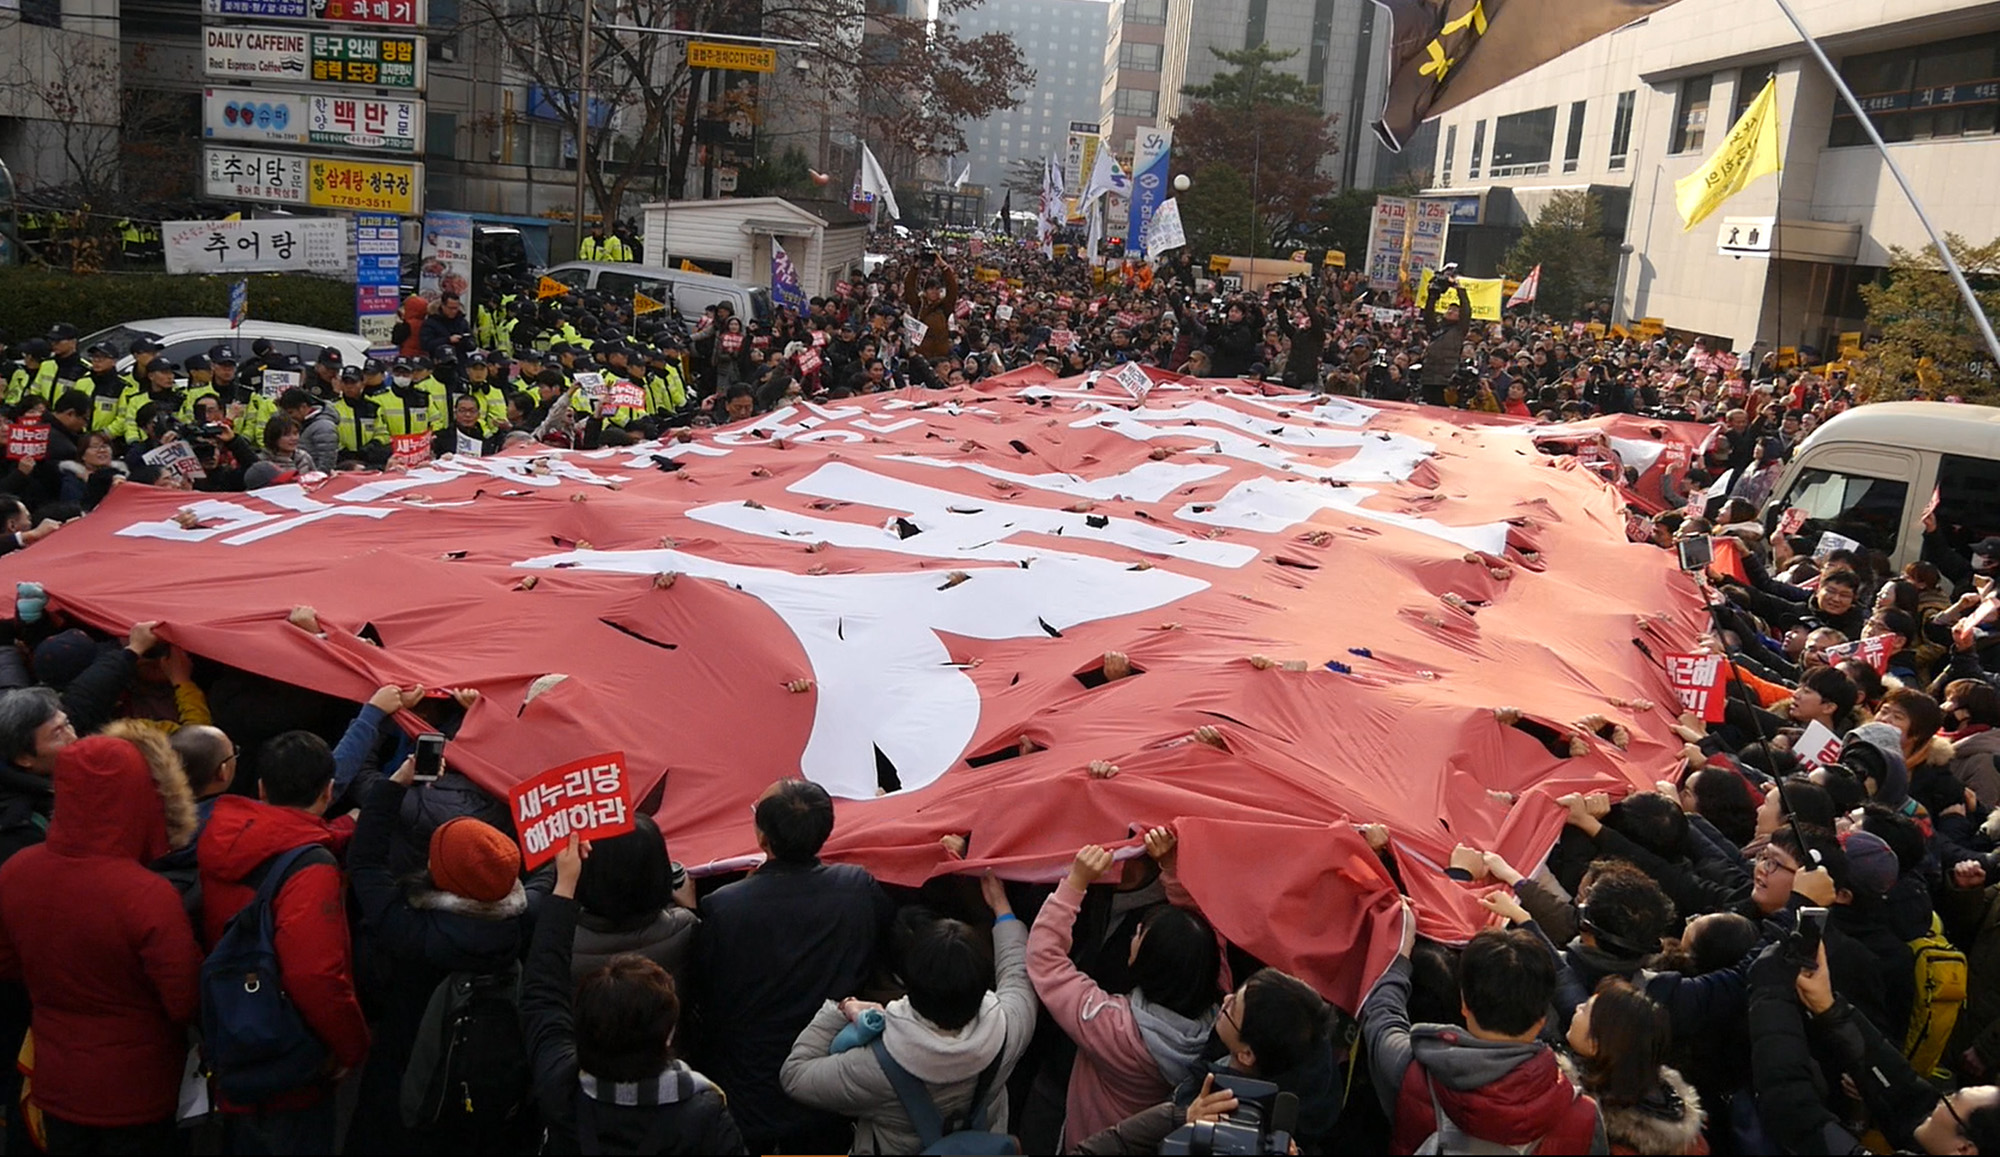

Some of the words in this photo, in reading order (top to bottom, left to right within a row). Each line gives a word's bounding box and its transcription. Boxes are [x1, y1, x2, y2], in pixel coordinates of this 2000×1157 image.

[351, 0, 410, 22] 과메기
[208, 31, 243, 49] DAILY
[246, 34, 304, 53] CAFFEINE
[313, 36, 343, 57] 문구
[347, 38, 378, 60] 인쇄
[382, 41, 413, 62] 명함
[258, 60, 282, 73] Coffee
[313, 60, 342, 80] 출력
[347, 62, 378, 83] 도장
[1921, 84, 1956, 107] 치과
[334, 100, 389, 134] 백반
[397, 104, 410, 136] 전문
[1142, 133, 1164, 149] Sh
[222, 153, 287, 187] 추어탕
[331, 194, 392, 209] T.783-3511
[1379, 202, 1406, 219] 치과
[1418, 221, 1441, 234] 안경
[203, 230, 298, 263] 추어탕
[519, 762, 621, 822] 새누리당
[524, 796, 627, 855] 해체하라
